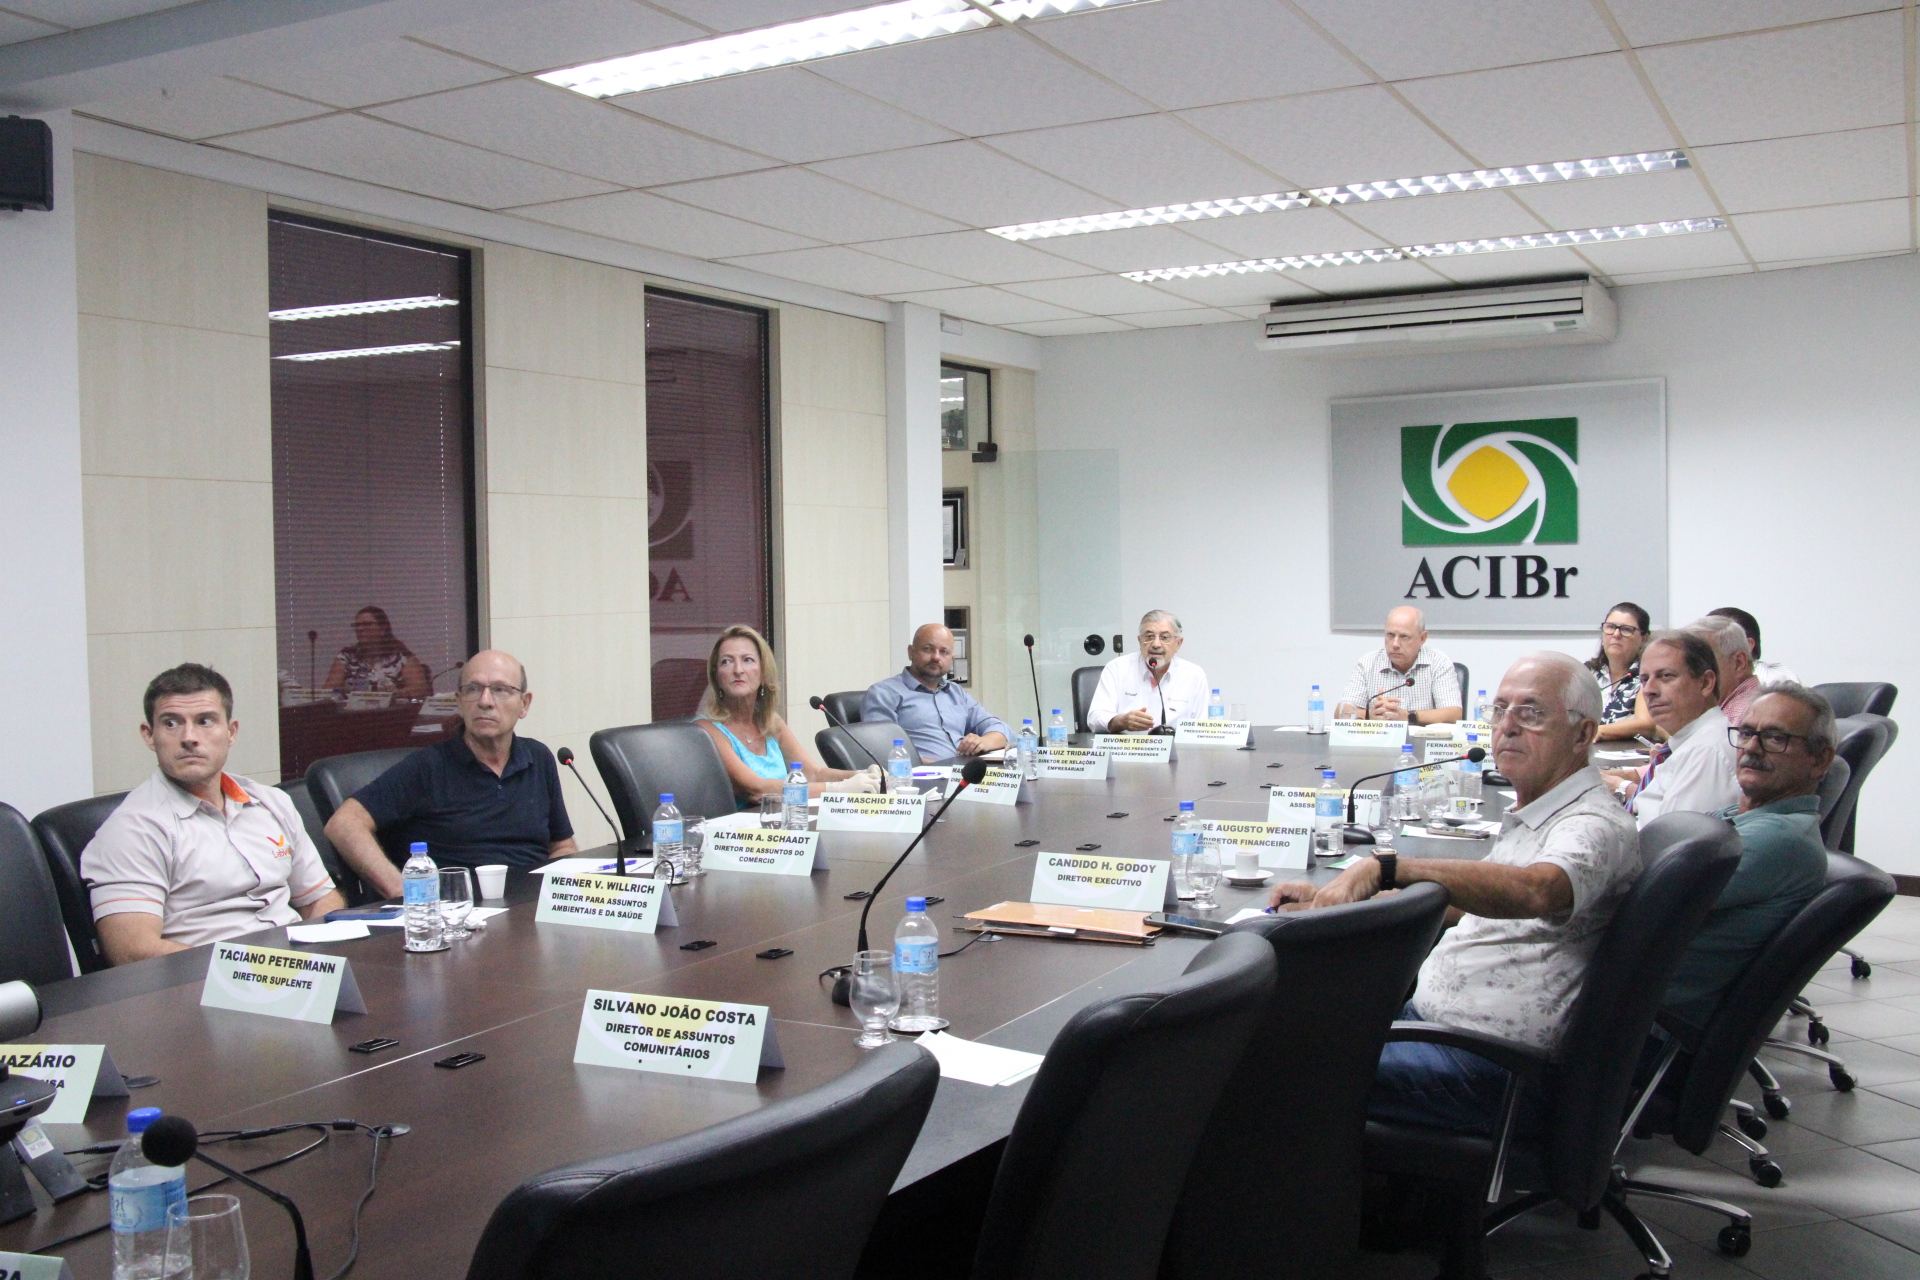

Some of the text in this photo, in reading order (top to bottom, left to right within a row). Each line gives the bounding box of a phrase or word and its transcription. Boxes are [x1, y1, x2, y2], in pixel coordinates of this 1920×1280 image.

[1404, 555, 1578, 599] ACIBr
[986, 770, 1021, 779] LENDOWSKY
[1202, 822, 1308, 835] SÉ AUGUSTO WERNER
[713, 831, 810, 845] ALTAMIR A. SCHAADT
[1203, 837, 1290, 847] DIRETOR FINANCEIRO
[714, 845, 744, 853] DIRETOR
[756, 847, 792, 856] ASSUNTOS
[738, 856, 775, 864] COMÉRCIO
[1049, 857, 1157, 874] CANDIDO H. GODOY
[551, 876, 655, 894] WERNER V. WILLRICH
[1057, 873, 1142, 887] DIRETOR EXECUTIVO
[552, 892, 648, 908] DIRETOR PARA ASSUNTOS
[552, 904, 596, 915] AMBIENTAIS
[617, 910, 643, 920] SAÚDE
[220, 948, 336, 974] TACIANO PETERMANN
[232, 971, 312, 990] DIRETOR SUPLENTE
[593, 998, 756, 1026] SILVANO JOÃO COSTA
[606, 1022, 735, 1045] DIRETOR DE ASSUNTOS
[624, 1041, 710, 1059] COMUNITÁRIOS
